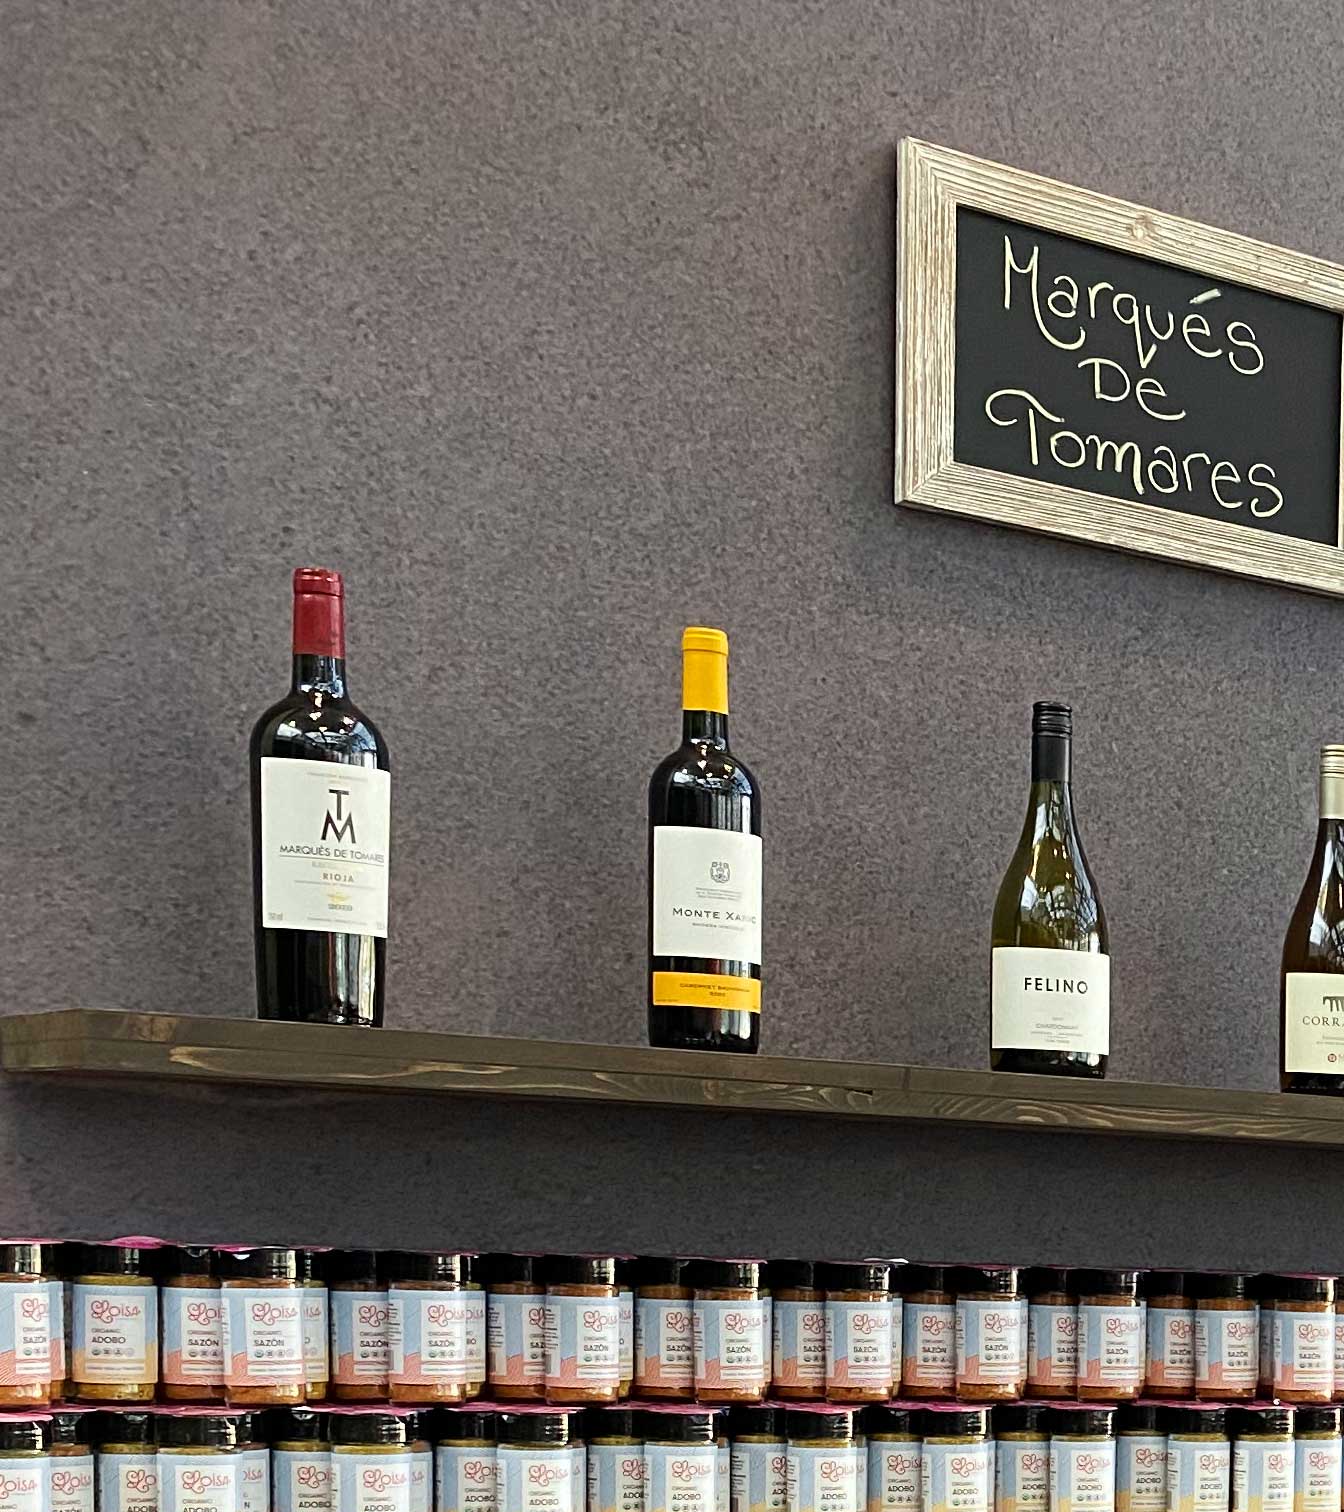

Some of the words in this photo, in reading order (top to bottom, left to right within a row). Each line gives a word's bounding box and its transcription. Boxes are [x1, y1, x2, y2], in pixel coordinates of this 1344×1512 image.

[1003, 234, 1264, 375] Marqués
[1078, 357, 1187, 421] De
[985, 389, 1284, 518] Tomares
[333, 849, 347, 858] DE
[322, 873, 355, 883] RIOJA
[672, 907, 720, 919] MONTE
[1024, 977, 1088, 994] FELINO
[91, 1336, 126, 1344] ADOBO
